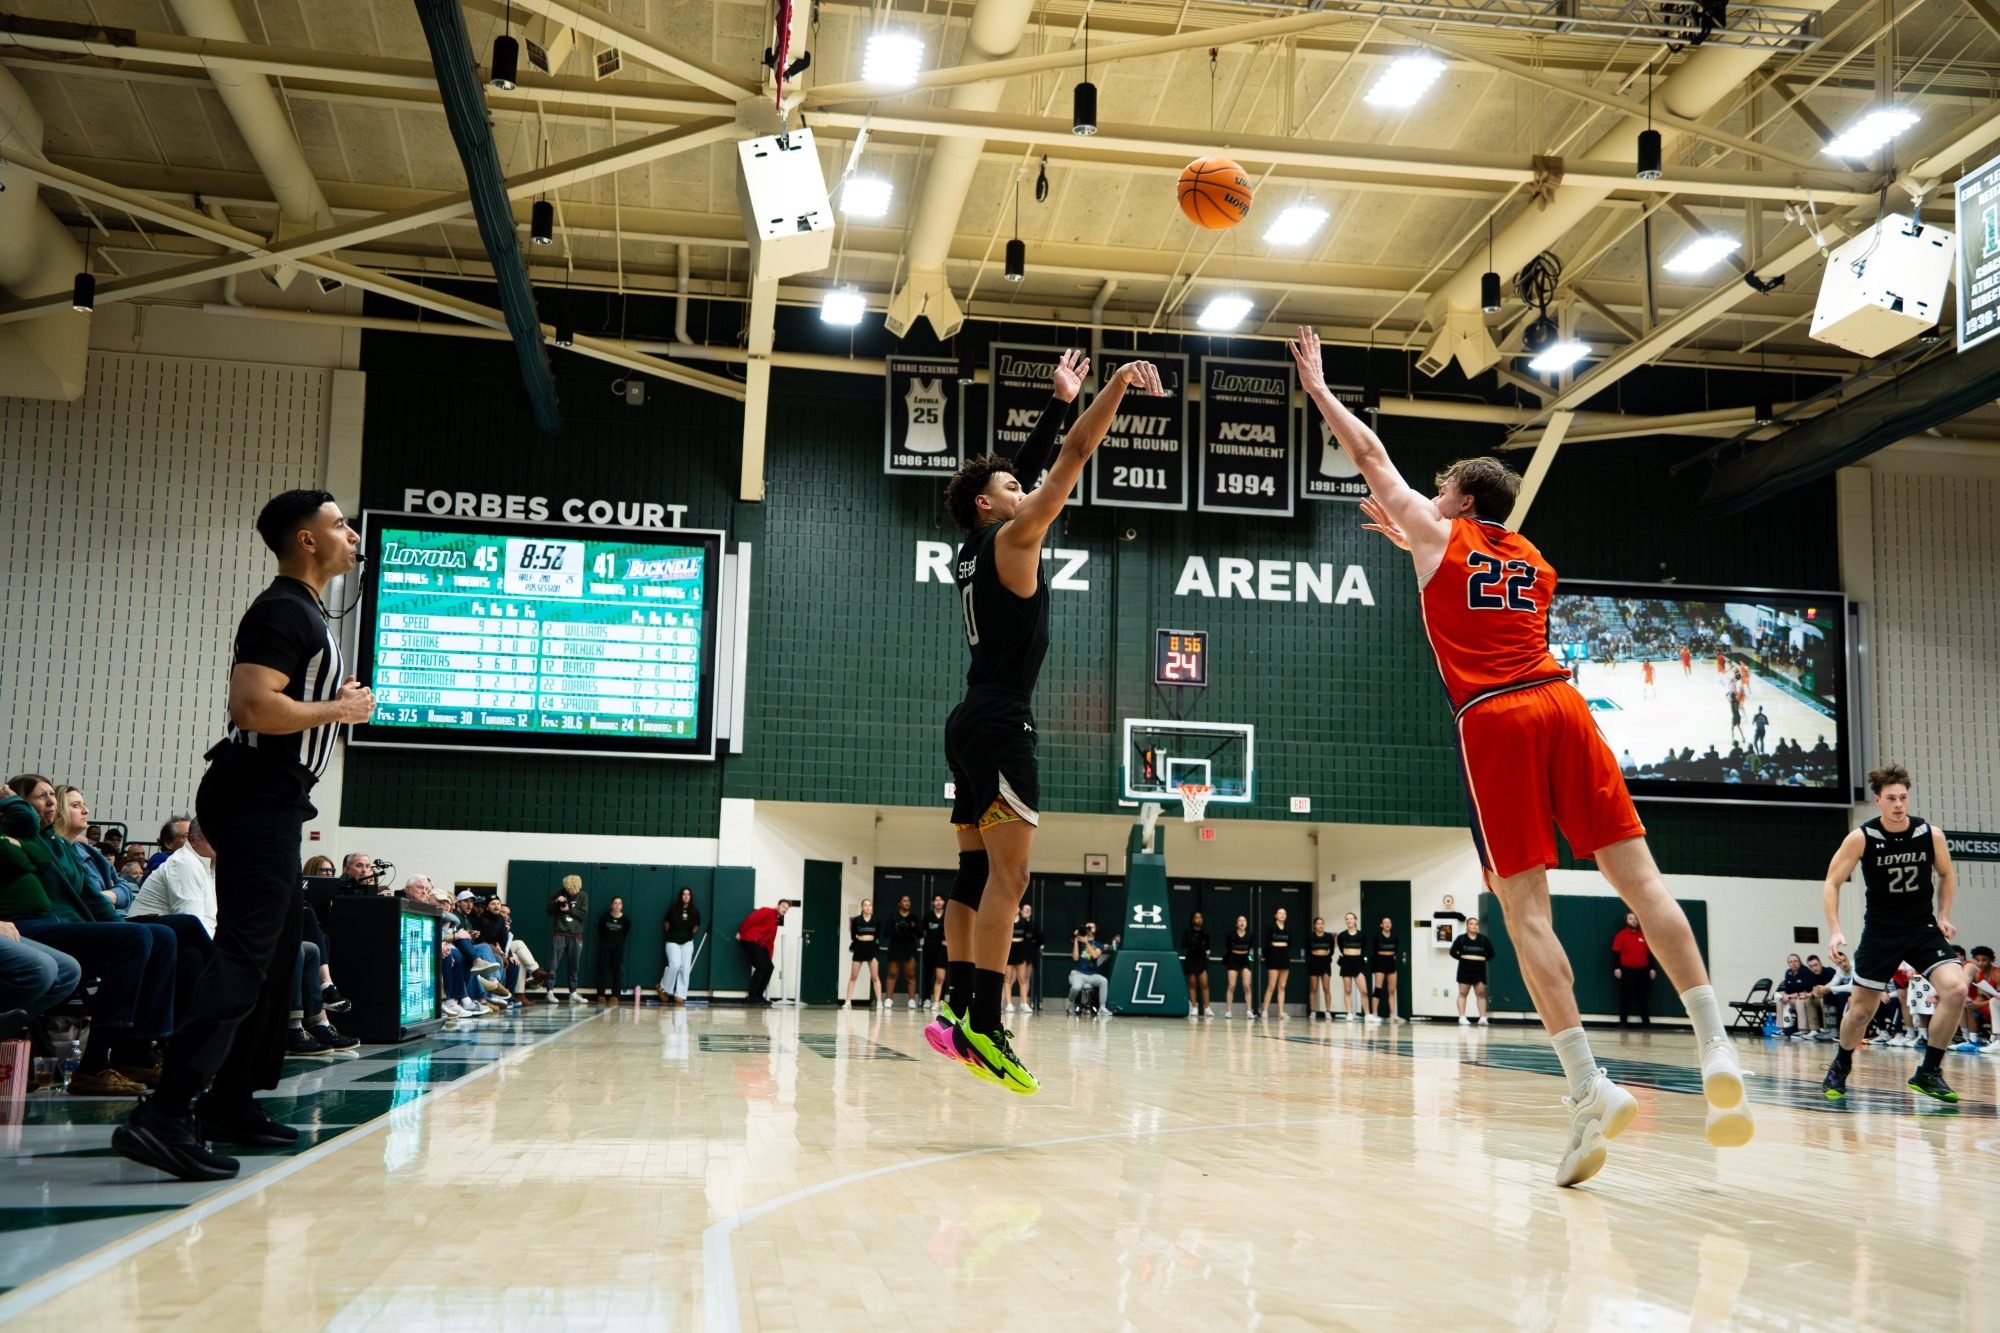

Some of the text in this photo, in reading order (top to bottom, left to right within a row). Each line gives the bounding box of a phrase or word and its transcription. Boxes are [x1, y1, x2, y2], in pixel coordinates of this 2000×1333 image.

[919, 365, 959, 374] SCHENNING
[999, 355, 1057, 379] LOYO
[1212, 369, 1285, 395] LOYOLA
[914, 396, 939, 405] LOYOLA
[1244, 396, 1279, 405] BASKETBALL
[913, 407, 939, 424] 25
[1110, 414, 1171, 436] WNIT
[1219, 422, 1276, 443] NCAA
[1102, 436, 1178, 451] 2ND ROUND
[1209, 443, 1285, 458] TOURNAMENT
[893, 454, 957, 467] 1986-1990
[1113, 466, 1167, 489] 2011
[1217, 473, 1276, 496] 1994
[1310, 480, 1368, 494] 1991-1995
[404, 488, 688, 528] FORBES COURT
[383, 543, 466, 568] LOYOLA
[474, 546, 498, 571] 45
[593, 553, 615, 578] 41
[629, 556, 699, 577] BUCKNELL
[437, 575, 443, 586] 3
[497, 577, 503, 589] 2
[525, 584, 561, 592] POSSESSION
[1174, 555, 1376, 606] ARENA
[1467, 550, 1538, 614] 22
[633, 585, 639, 597] 3
[963, 582, 979, 646] 0
[402, 616, 429, 629] SPEED
[565, 624, 608, 638] WILLIAMS
[401, 634, 440, 648] STIEMKE
[564, 643, 605, 656] PACHUCKI
[563, 662, 595, 674] BERGER
[1165, 652, 1197, 679] 24
[399, 672, 456, 686] COMMANDER
[398, 691, 441, 704] SPRINGER
[398, 709, 417, 722] 37.5
[460, 712, 473, 725] 30
[517, 714, 528, 727] 12
[562, 716, 583, 729] 38.6
[622, 719, 634, 731] 24
[677, 721, 684, 734] 8
[1294, 800, 1307, 810] EXIT
[1946, 839, 2000, 854] ONCESS
[1877, 852, 1927, 866] LOYOLA
[1888, 866, 1919, 893] 22
[1131, 962, 1165, 1004] L
